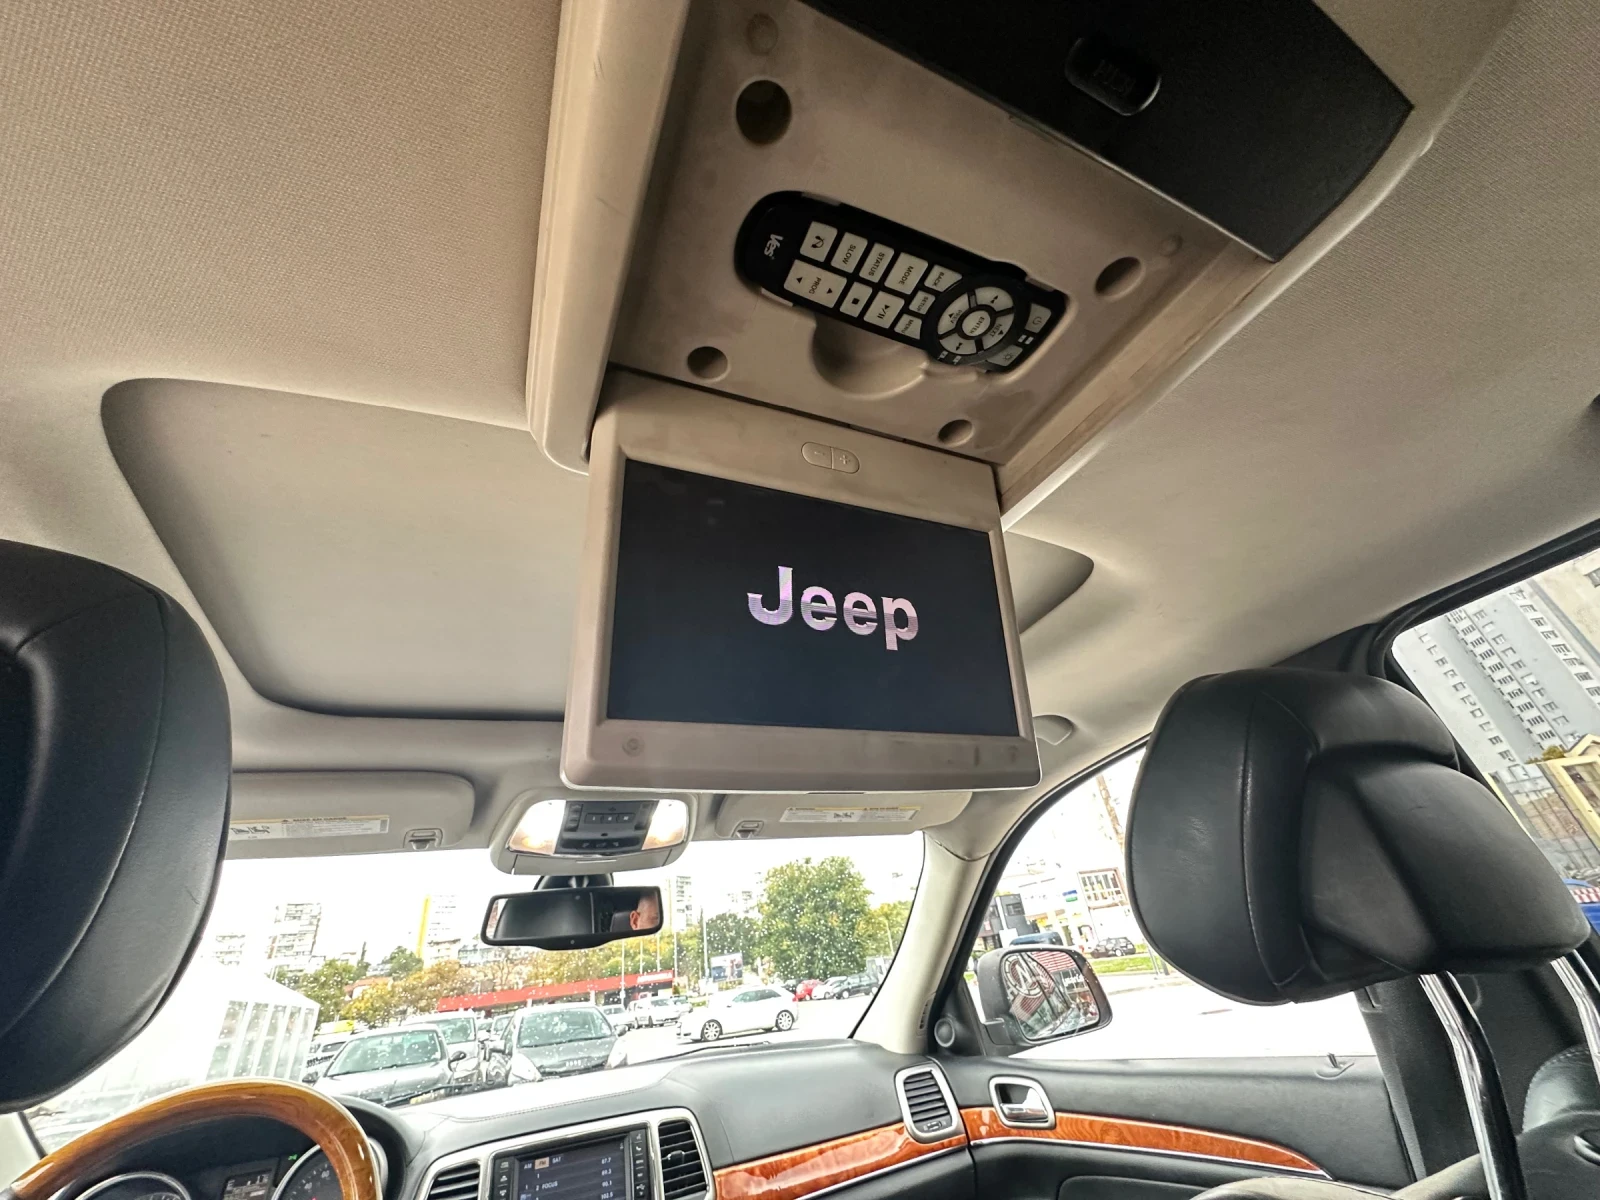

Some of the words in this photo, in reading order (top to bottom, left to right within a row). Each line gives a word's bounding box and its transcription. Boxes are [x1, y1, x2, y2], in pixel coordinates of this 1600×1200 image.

[842, 244, 856, 265] SLOW
[868, 252, 885, 276] STATUS
[899, 265, 914, 285] MODE
[932, 271, 945, 287] BACK
[808, 277, 822, 295] PROG
[916, 296, 929, 312] SETUP
[949, 309, 963, 324] PREV
[902, 319, 914, 335] MENU
[970, 316, 985, 335] ENTER
[989, 323, 1002, 338] NEXT
[747, 565, 920, 651] Jeep
[541, 1181, 559, 1190] FOCUS
